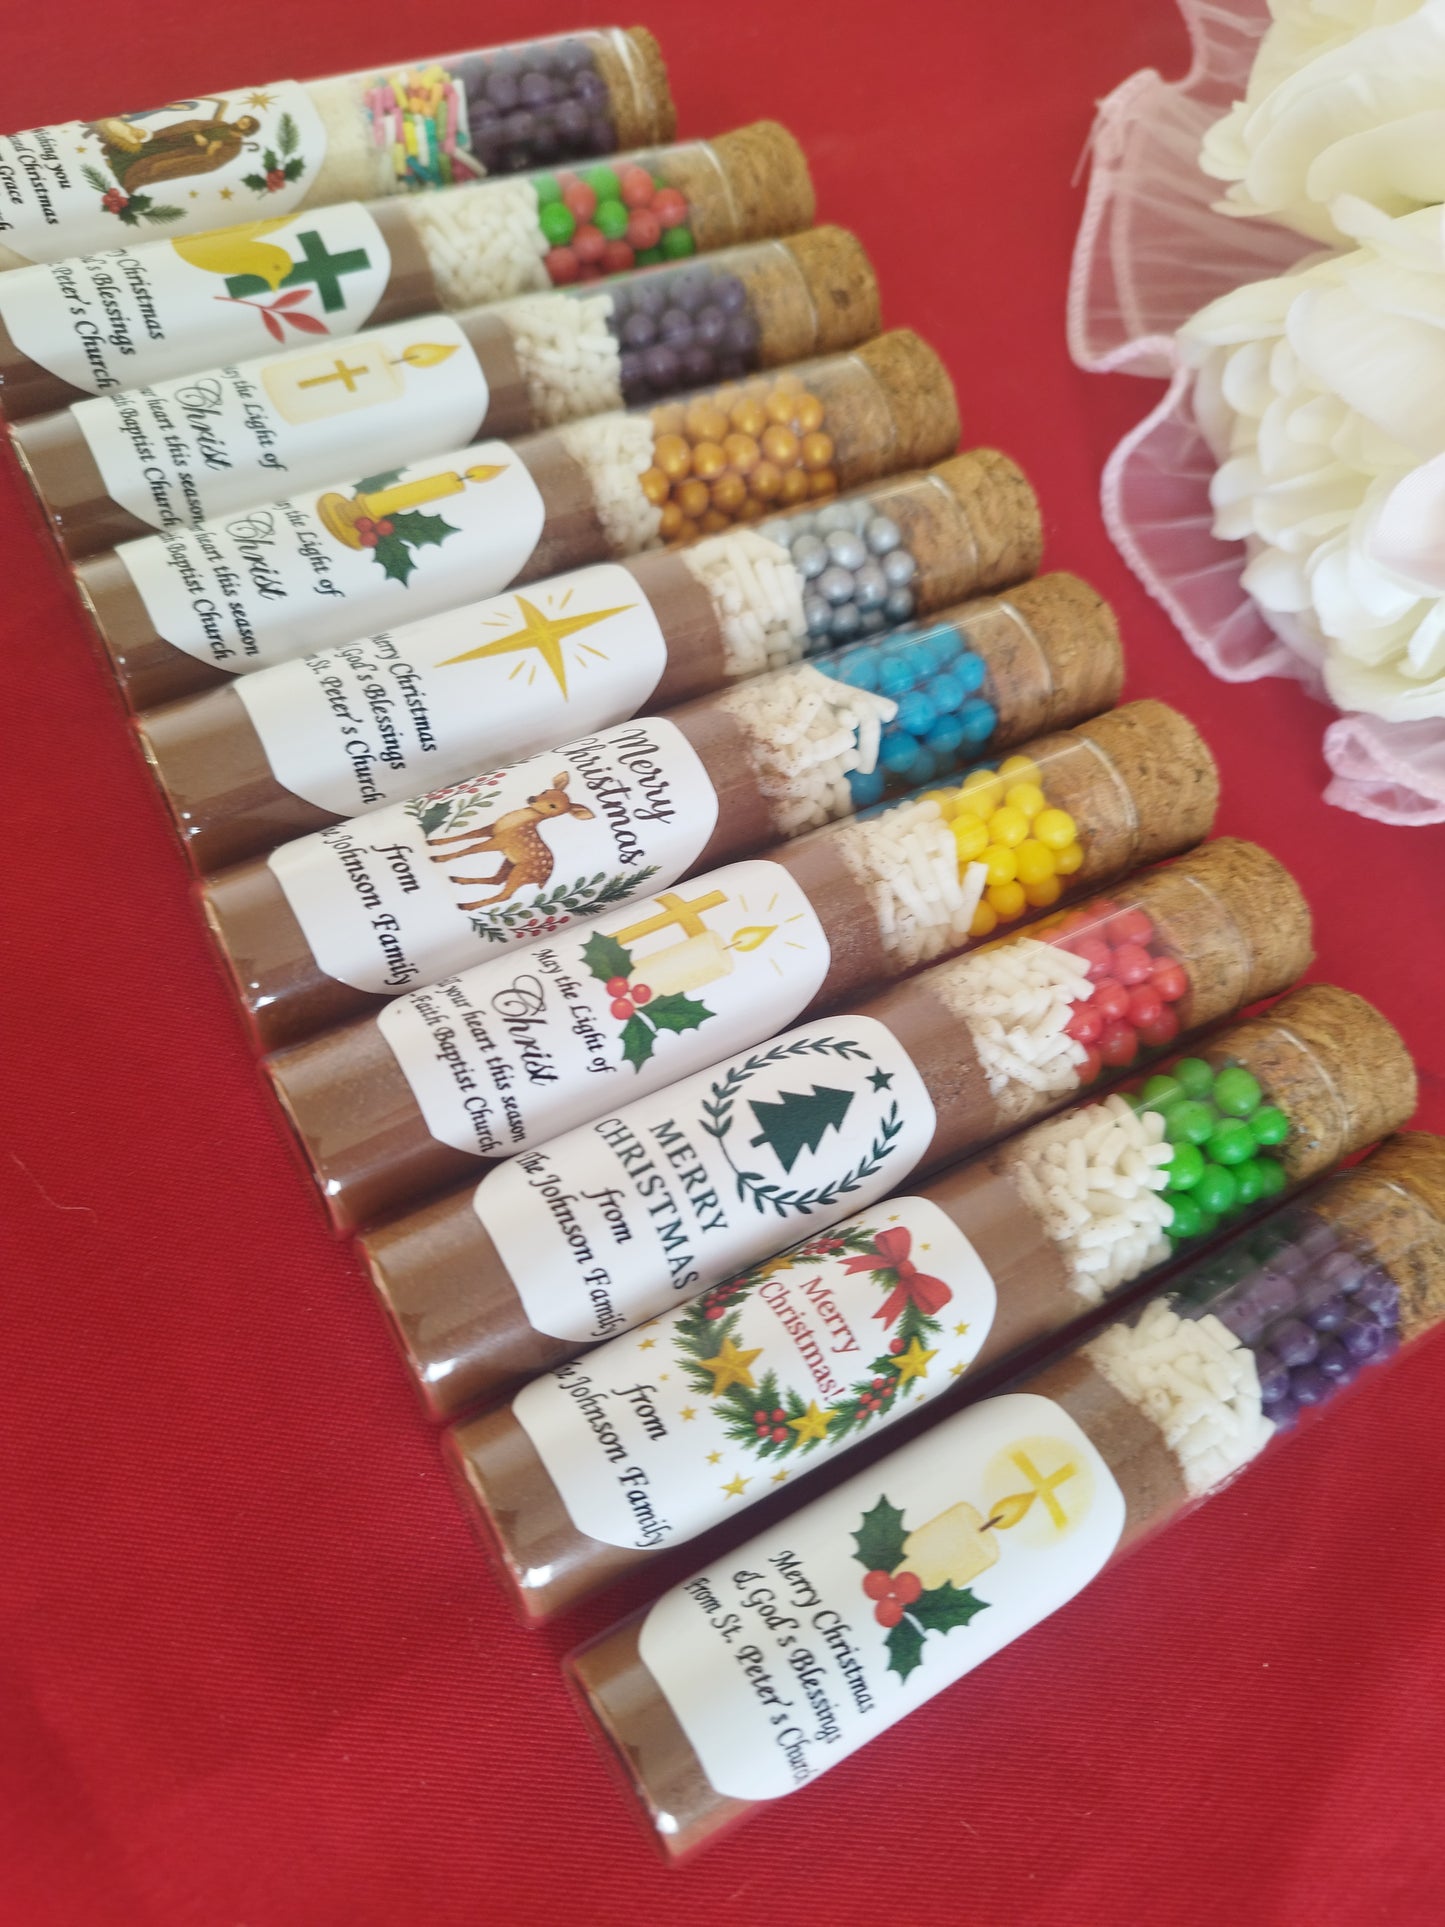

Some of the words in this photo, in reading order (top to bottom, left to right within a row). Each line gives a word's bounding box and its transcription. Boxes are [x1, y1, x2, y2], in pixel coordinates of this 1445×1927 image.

[17, 155, 59, 225] Christmas
[44, 164, 72, 188] you
[51, 266, 92, 315] Peter's
[74, 320, 121, 389] Church
[91, 272, 136, 355] Blessings
[116, 258, 165, 340] Christmas
[174, 378, 233, 471] Christ
[233, 379, 257, 399] the
[243, 403, 278, 448] Light
[118, 407, 157, 463] Baptist
[143, 467, 184, 527] Church
[147, 398, 175, 431] heart
[164, 434, 191, 467] this
[178, 471, 205, 523] season
[258, 452, 289, 472] of
[225, 510, 288, 601] Christ
[285, 510, 311, 528] the
[296, 530, 332, 575] Light
[166, 542, 206, 595] Baptist
[192, 598, 237, 661] Church
[194, 530, 225, 563] heart
[213, 564, 241, 597] this
[228, 601, 259, 657] season
[313, 578, 346, 598] of
[319, 675, 364, 735] Peter's
[345, 739, 386, 805] Church
[362, 683, 406, 770] Blessings
[388, 662, 437, 752] Christmas
[551, 737, 645, 866] Christmas
[607, 728, 676, 824] Merry
[323, 834, 383, 910] Johnson
[370, 913, 420, 986] Family
[370, 844, 421, 895] from
[531, 948, 564, 975] May
[553, 975, 582, 1000] the
[435, 985, 472, 1008] your
[460, 1010, 496, 1054] heart
[485, 1055, 515, 1091] this
[500, 1095, 527, 1144] season
[490, 974, 559, 1087] Christ
[568, 1004, 607, 1054] Light
[586, 1056, 617, 1075] of
[432, 1025, 478, 1093] Baptist
[463, 1095, 504, 1154] Church
[516, 1151, 551, 1175] The
[593, 1117, 700, 1290] CHRISTMAS
[648, 1118, 729, 1234] MERRY
[528, 1174, 596, 1265] Johnson
[580, 1187, 634, 1245] from
[583, 1267, 627, 1337] Family
[758, 1281, 846, 1401] Christmas!
[798, 1275, 861, 1354] Merry
[610, 1383, 670, 1442] from
[558, 1376, 630, 1464] Johnson
[617, 1466, 673, 1548] Family
[683, 1577, 722, 1615] from
[710, 1613, 744, 1644] St.
[734, 1644, 794, 1725] Peter's
[732, 1569, 766, 1591] &
[787, 1647, 843, 1744] Blessings
[767, 1549, 822, 1608] Merry
[811, 1609, 876, 1714] Christmas
